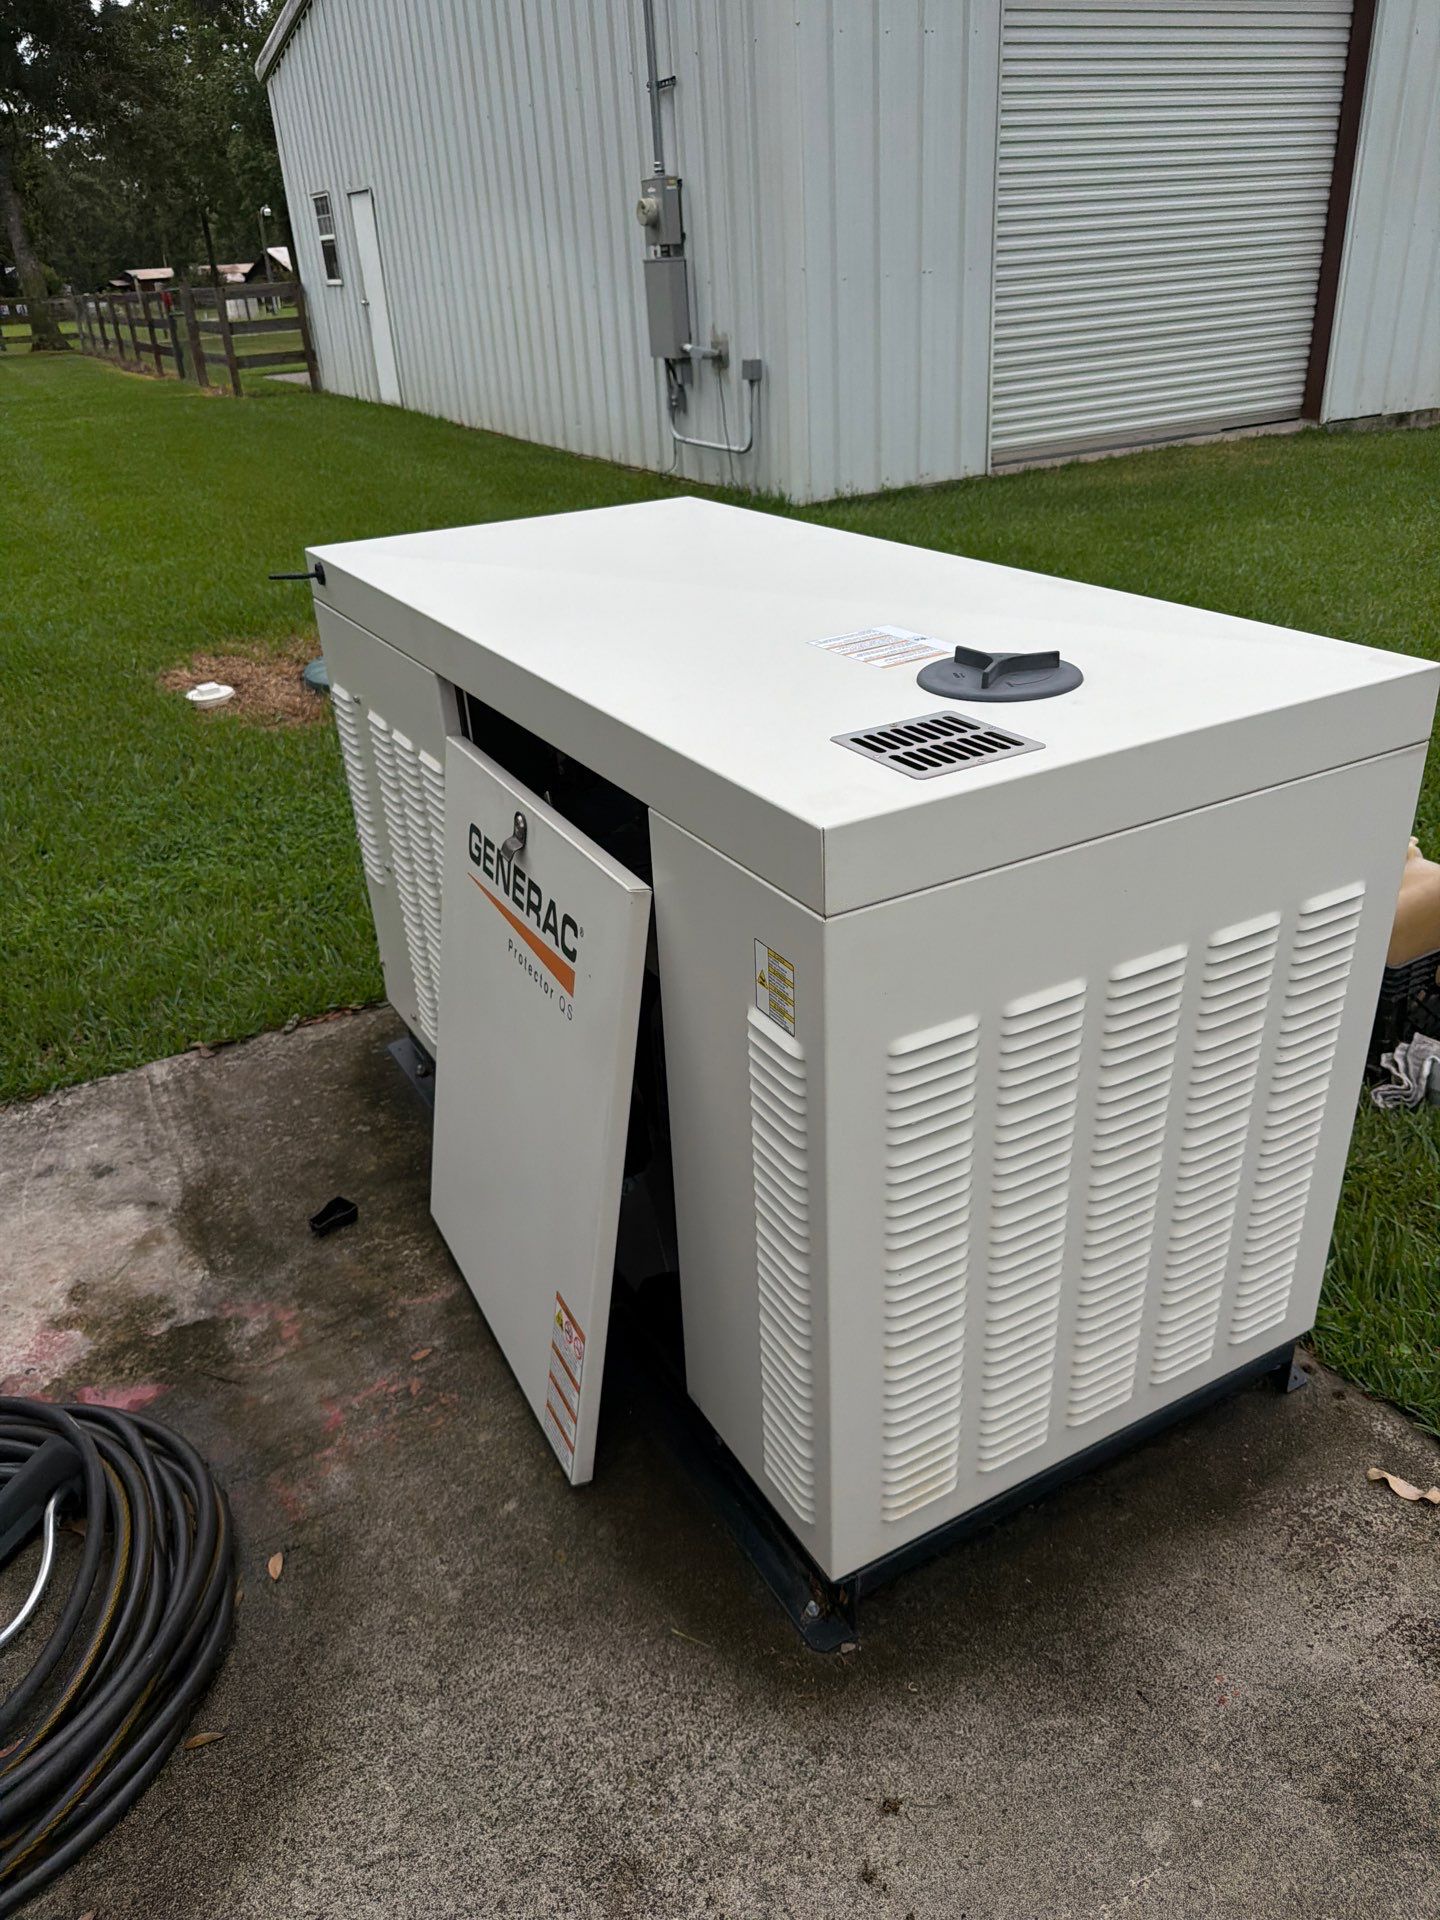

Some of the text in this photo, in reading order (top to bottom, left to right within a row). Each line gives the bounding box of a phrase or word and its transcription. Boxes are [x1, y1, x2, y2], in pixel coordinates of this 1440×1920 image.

[468, 822, 579, 963] GENERAC
[508, 938, 573, 1021] Protector QS
